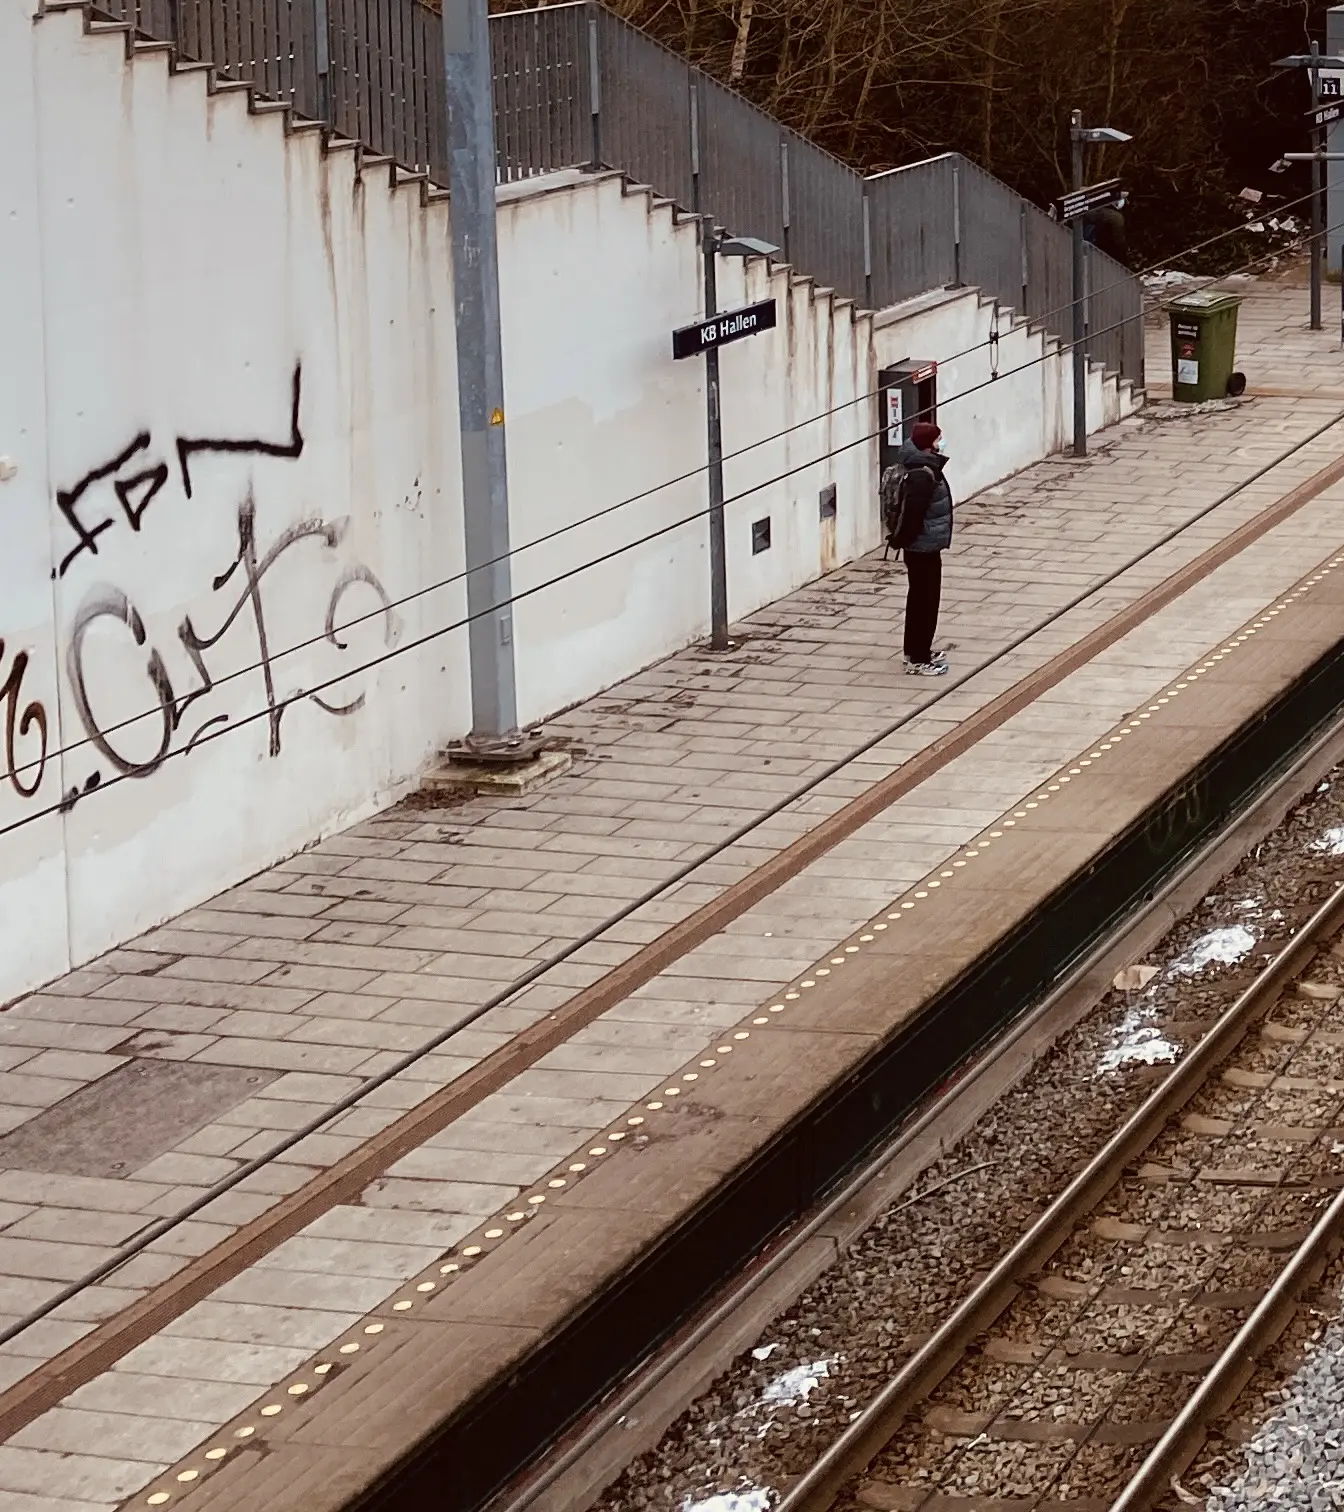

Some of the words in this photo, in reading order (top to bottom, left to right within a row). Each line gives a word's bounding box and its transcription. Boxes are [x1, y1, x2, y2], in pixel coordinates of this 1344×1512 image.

[1323, 83, 1338, 95] 11
[701, 325, 717, 345] KB
[720, 314, 757, 338] Hallen
